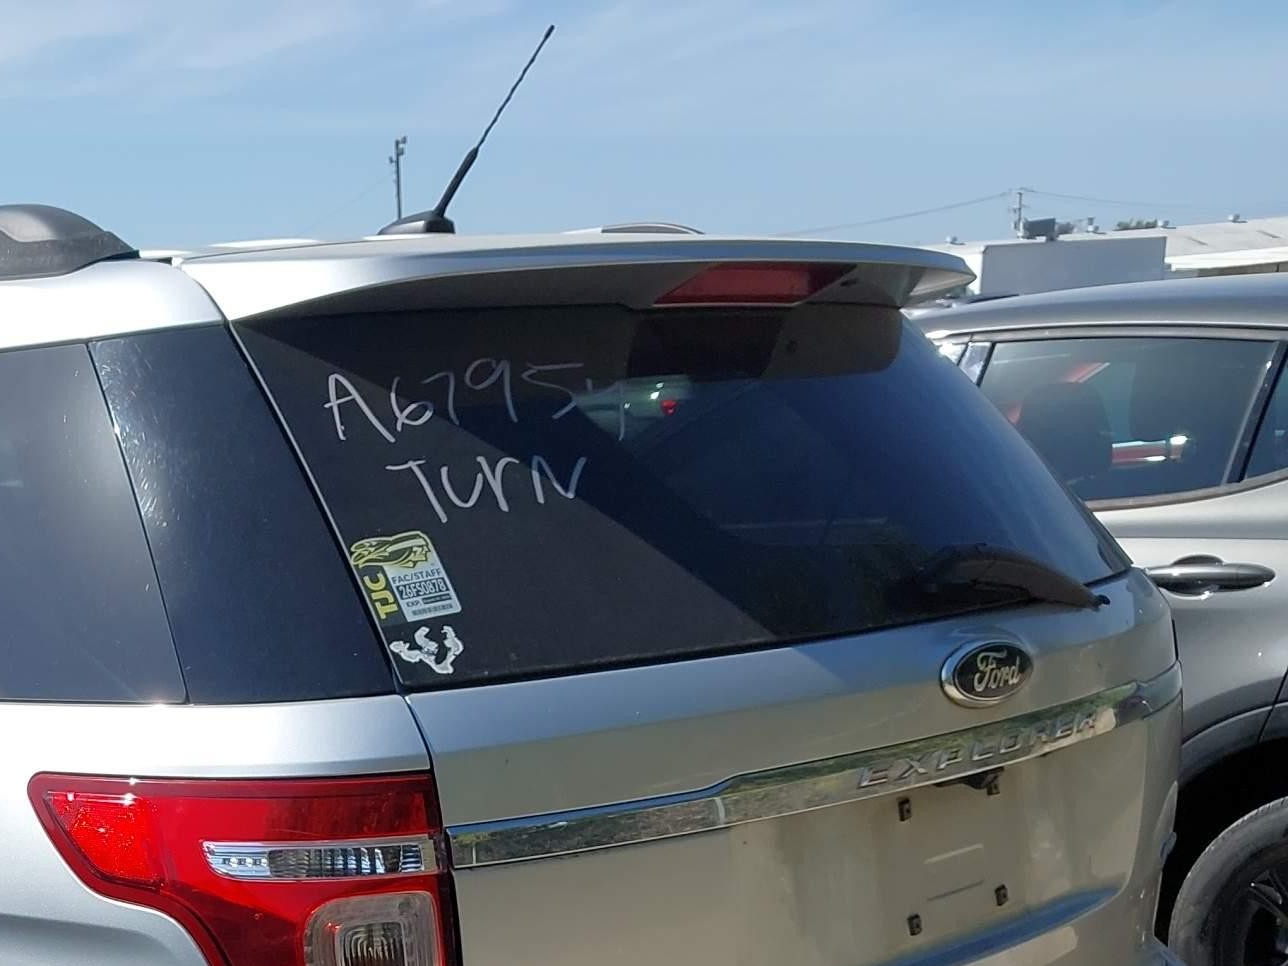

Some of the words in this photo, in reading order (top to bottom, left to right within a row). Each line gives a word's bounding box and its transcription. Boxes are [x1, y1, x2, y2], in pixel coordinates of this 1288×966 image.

[363, 571, 398, 619] TJC
[392, 568, 441, 585] FAC/STAFF
[398, 579, 447, 599] 26FS0878
[973, 650, 1021, 692] Ford
[857, 711, 1098, 790] EXPLORER
